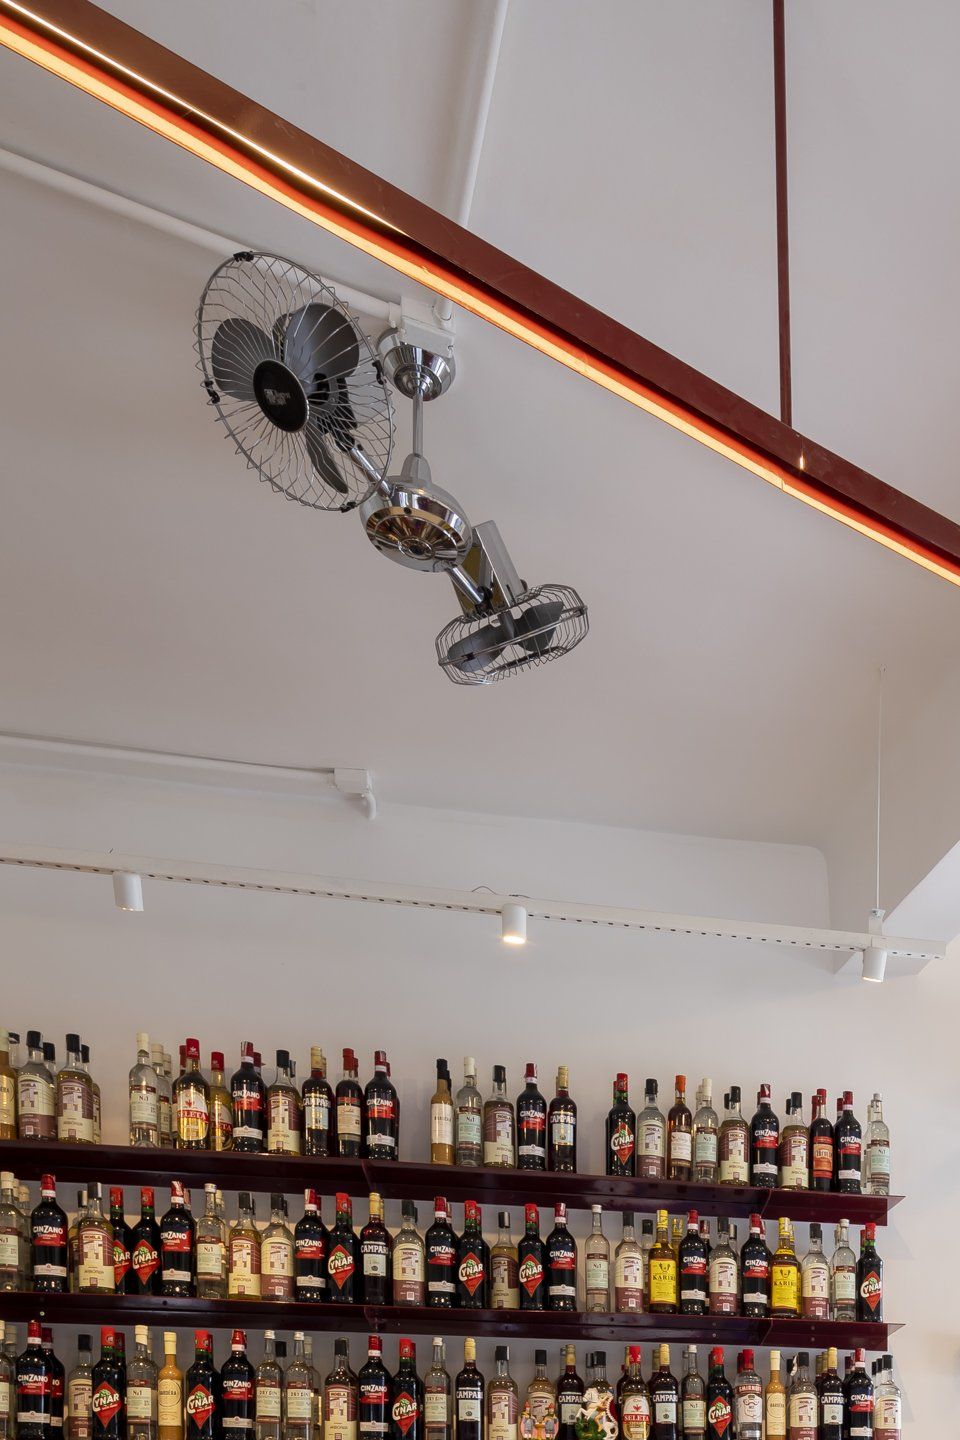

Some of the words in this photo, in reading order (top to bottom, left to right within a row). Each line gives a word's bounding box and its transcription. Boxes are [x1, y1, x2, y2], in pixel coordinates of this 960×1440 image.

[33, 1225, 63, 1235] CINZANO
[161, 1231, 188, 1240] CINZANO
[295, 1238, 322, 1248] CINZANO
[132, 1250, 159, 1270] CYNAR
[550, 1250, 575, 1259] CINZANO
[328, 1255, 353, 1275] CYNAR
[459, 1263, 484, 1283] CYNAR
[519, 1264, 543, 1284] CYNAR
[18, 1373, 48, 1383] CINZANO
[223, 1380, 252, 1389] CINZANO
[361, 1384, 387, 1393] CINZANO
[93, 1392, 119, 1412] CYNAR
[187, 1394, 214, 1415] CYNAR
[393, 1402, 418, 1421] CYNAR
[708, 1405, 731, 1424] CYNAR
